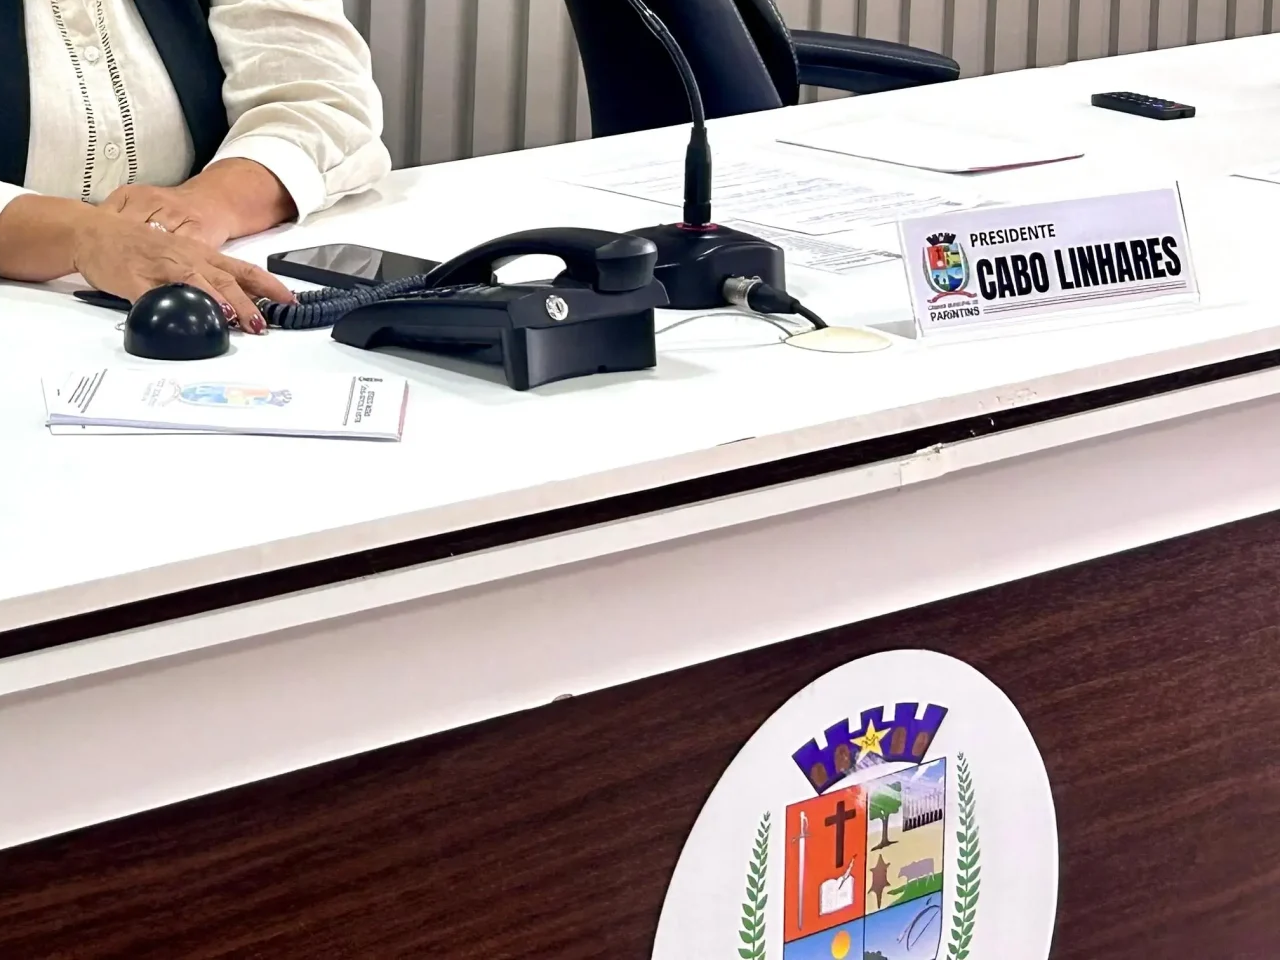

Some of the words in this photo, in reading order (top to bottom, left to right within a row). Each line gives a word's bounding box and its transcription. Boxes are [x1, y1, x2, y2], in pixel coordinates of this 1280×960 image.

[970, 223, 1056, 248] PRESIDENTE
[976, 251, 1050, 301] CABO
[1054, 235, 1183, 291] LINHARES
